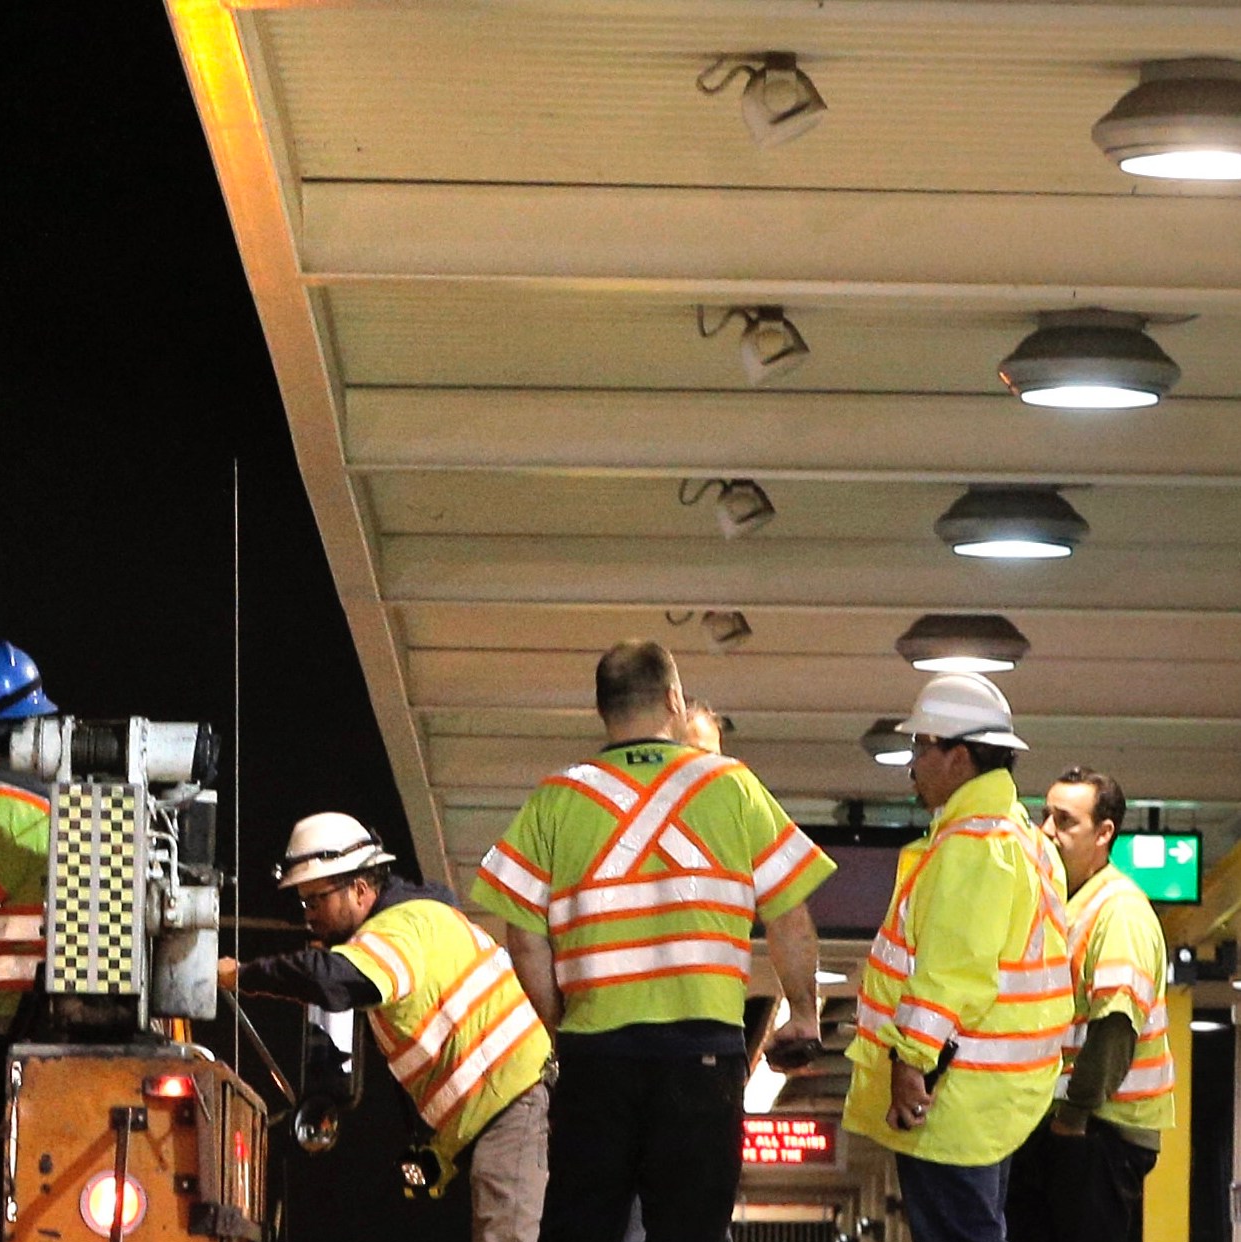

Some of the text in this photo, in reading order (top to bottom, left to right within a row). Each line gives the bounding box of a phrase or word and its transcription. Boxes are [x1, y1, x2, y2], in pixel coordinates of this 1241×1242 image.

[792, 1121, 816, 1135] NOT
[755, 1134, 780, 1148] ALL
[783, 1134, 827, 1150] TRAINS
[780, 1148, 802, 1163] THE
